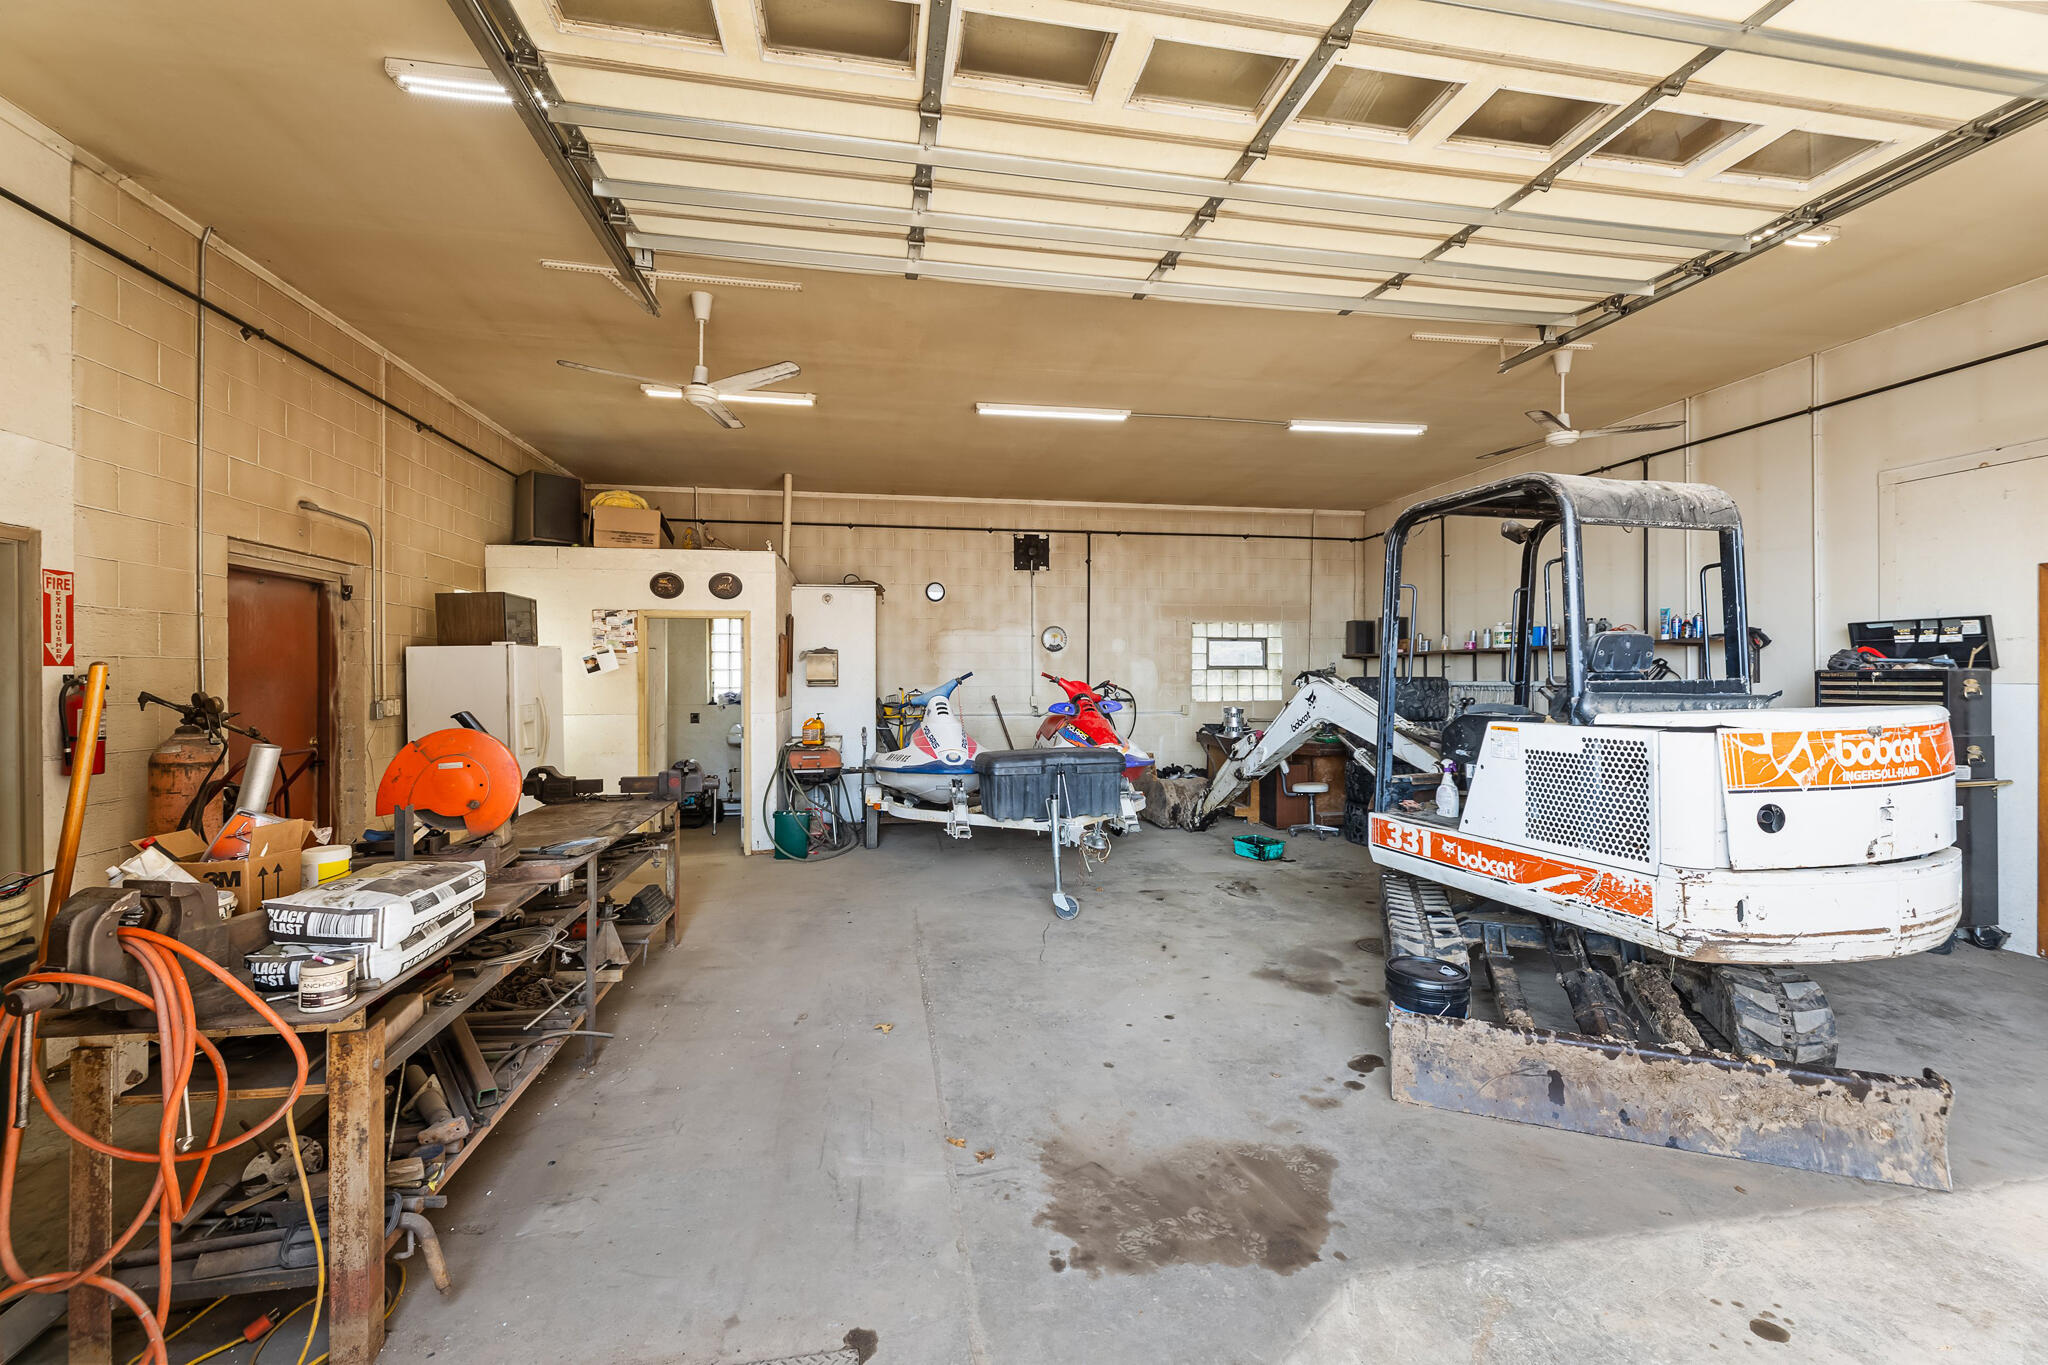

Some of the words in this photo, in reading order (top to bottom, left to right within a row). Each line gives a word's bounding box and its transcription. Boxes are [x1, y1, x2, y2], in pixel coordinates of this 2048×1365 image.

[46, 577, 71, 590] FIRE
[1291, 711, 1311, 732] bobcat
[923, 725, 940, 749] POLARIS
[1066, 723, 1089, 740] POLARIS
[1834, 731, 1922, 767] bobcat
[1387, 823, 1431, 857] 331
[1457, 846, 1516, 880] bobcat
[203, 870, 241, 888] 3M
[267, 908, 307, 924] BLACK
[302, 980, 338, 989] ANCHOR
